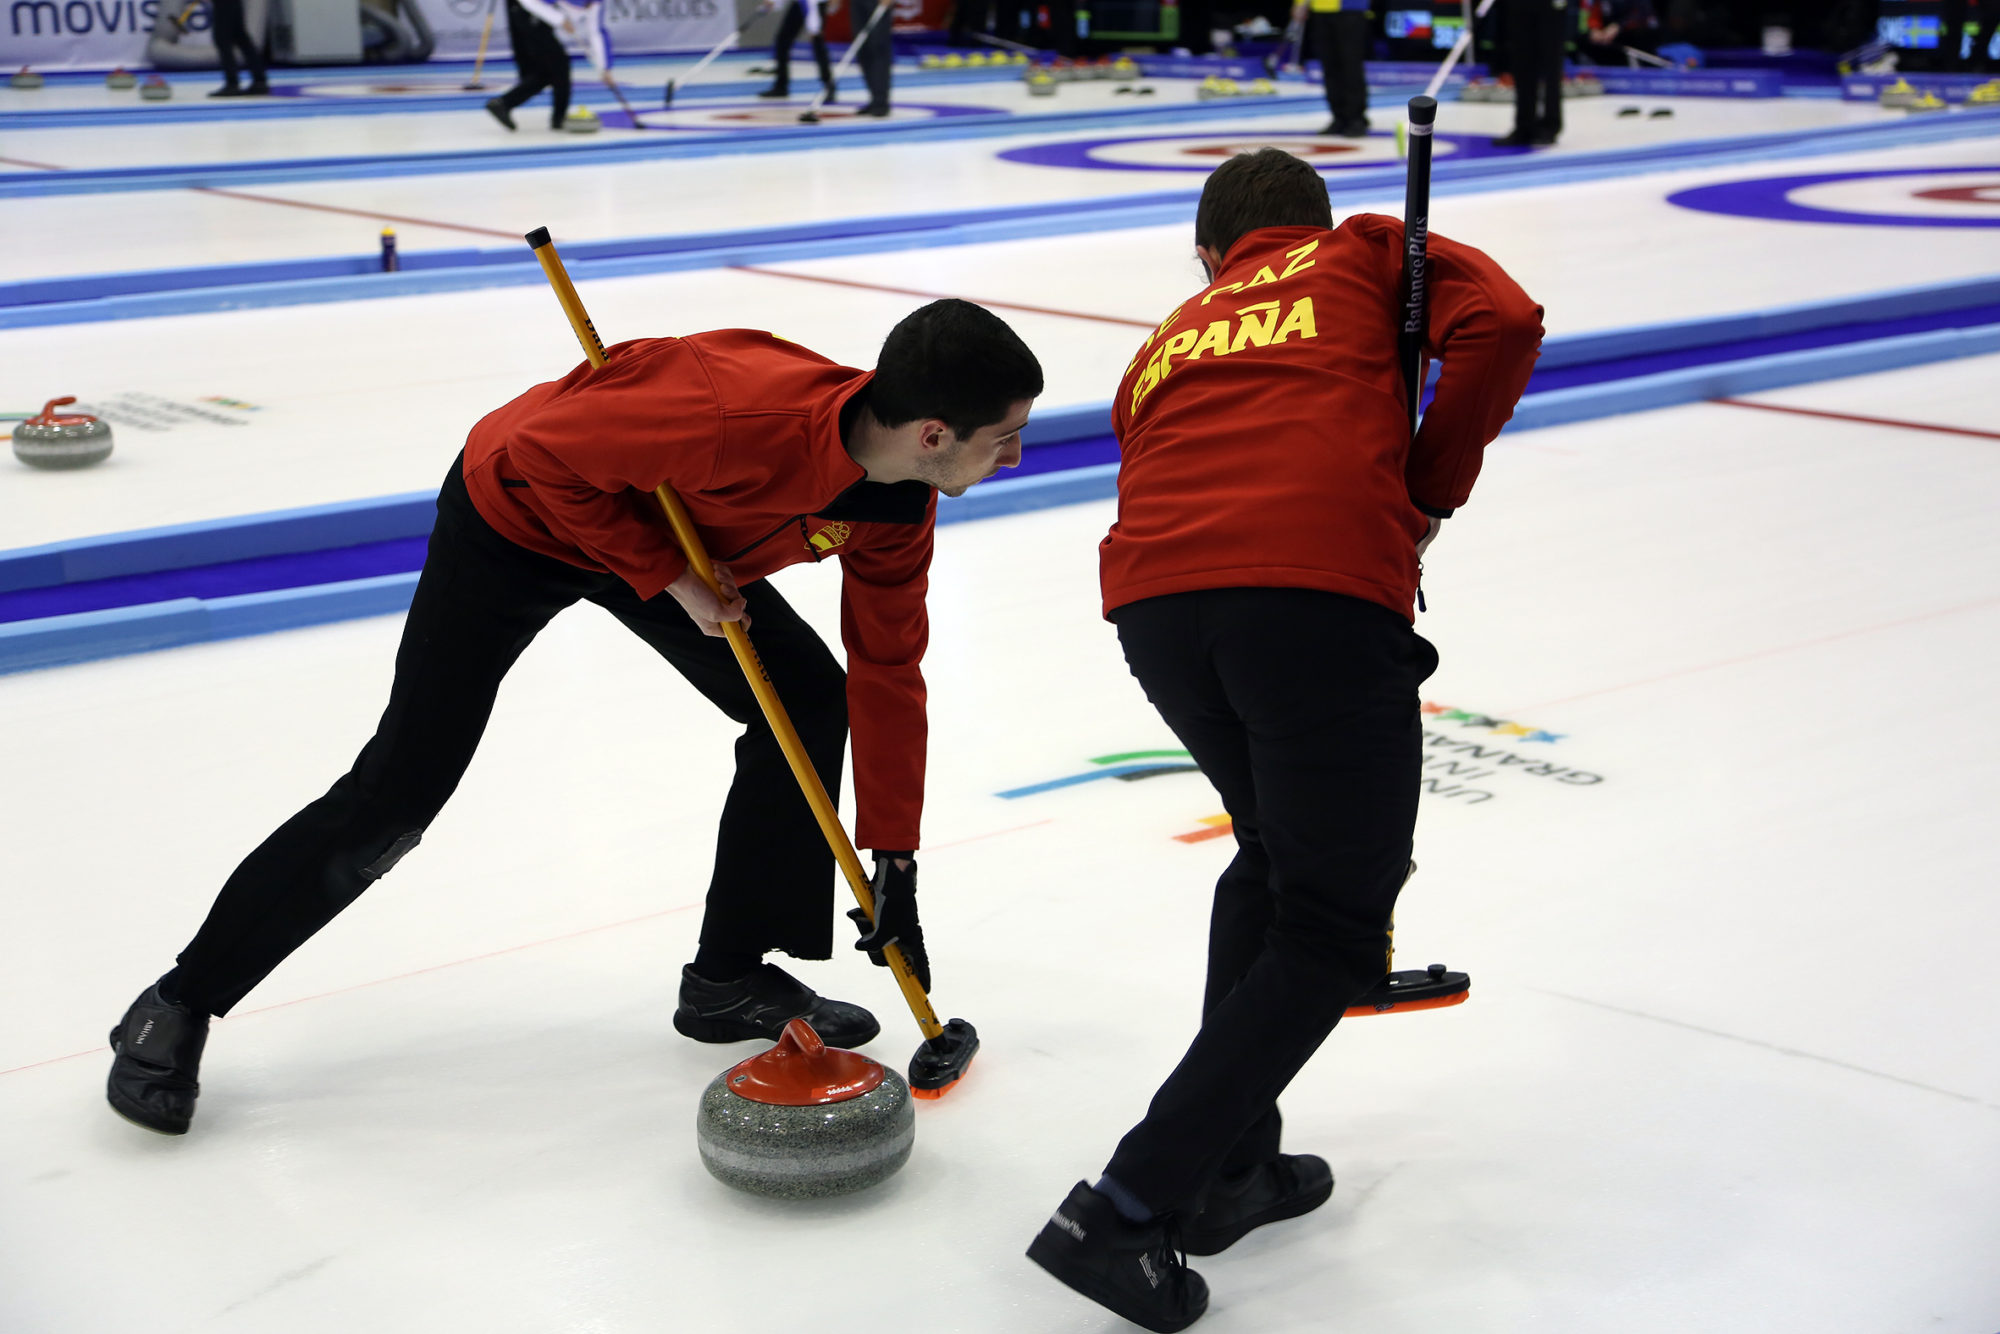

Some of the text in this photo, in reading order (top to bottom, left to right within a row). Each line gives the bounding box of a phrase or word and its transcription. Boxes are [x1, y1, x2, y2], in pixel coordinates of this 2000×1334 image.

[11, 0, 213, 35] movisa
[1404, 216, 1429, 334] BalancePlus
[1131, 296, 1319, 417] ESPAÑA
[1422, 755, 1494, 781] IN
[1423, 732, 1604, 787] GRANA
